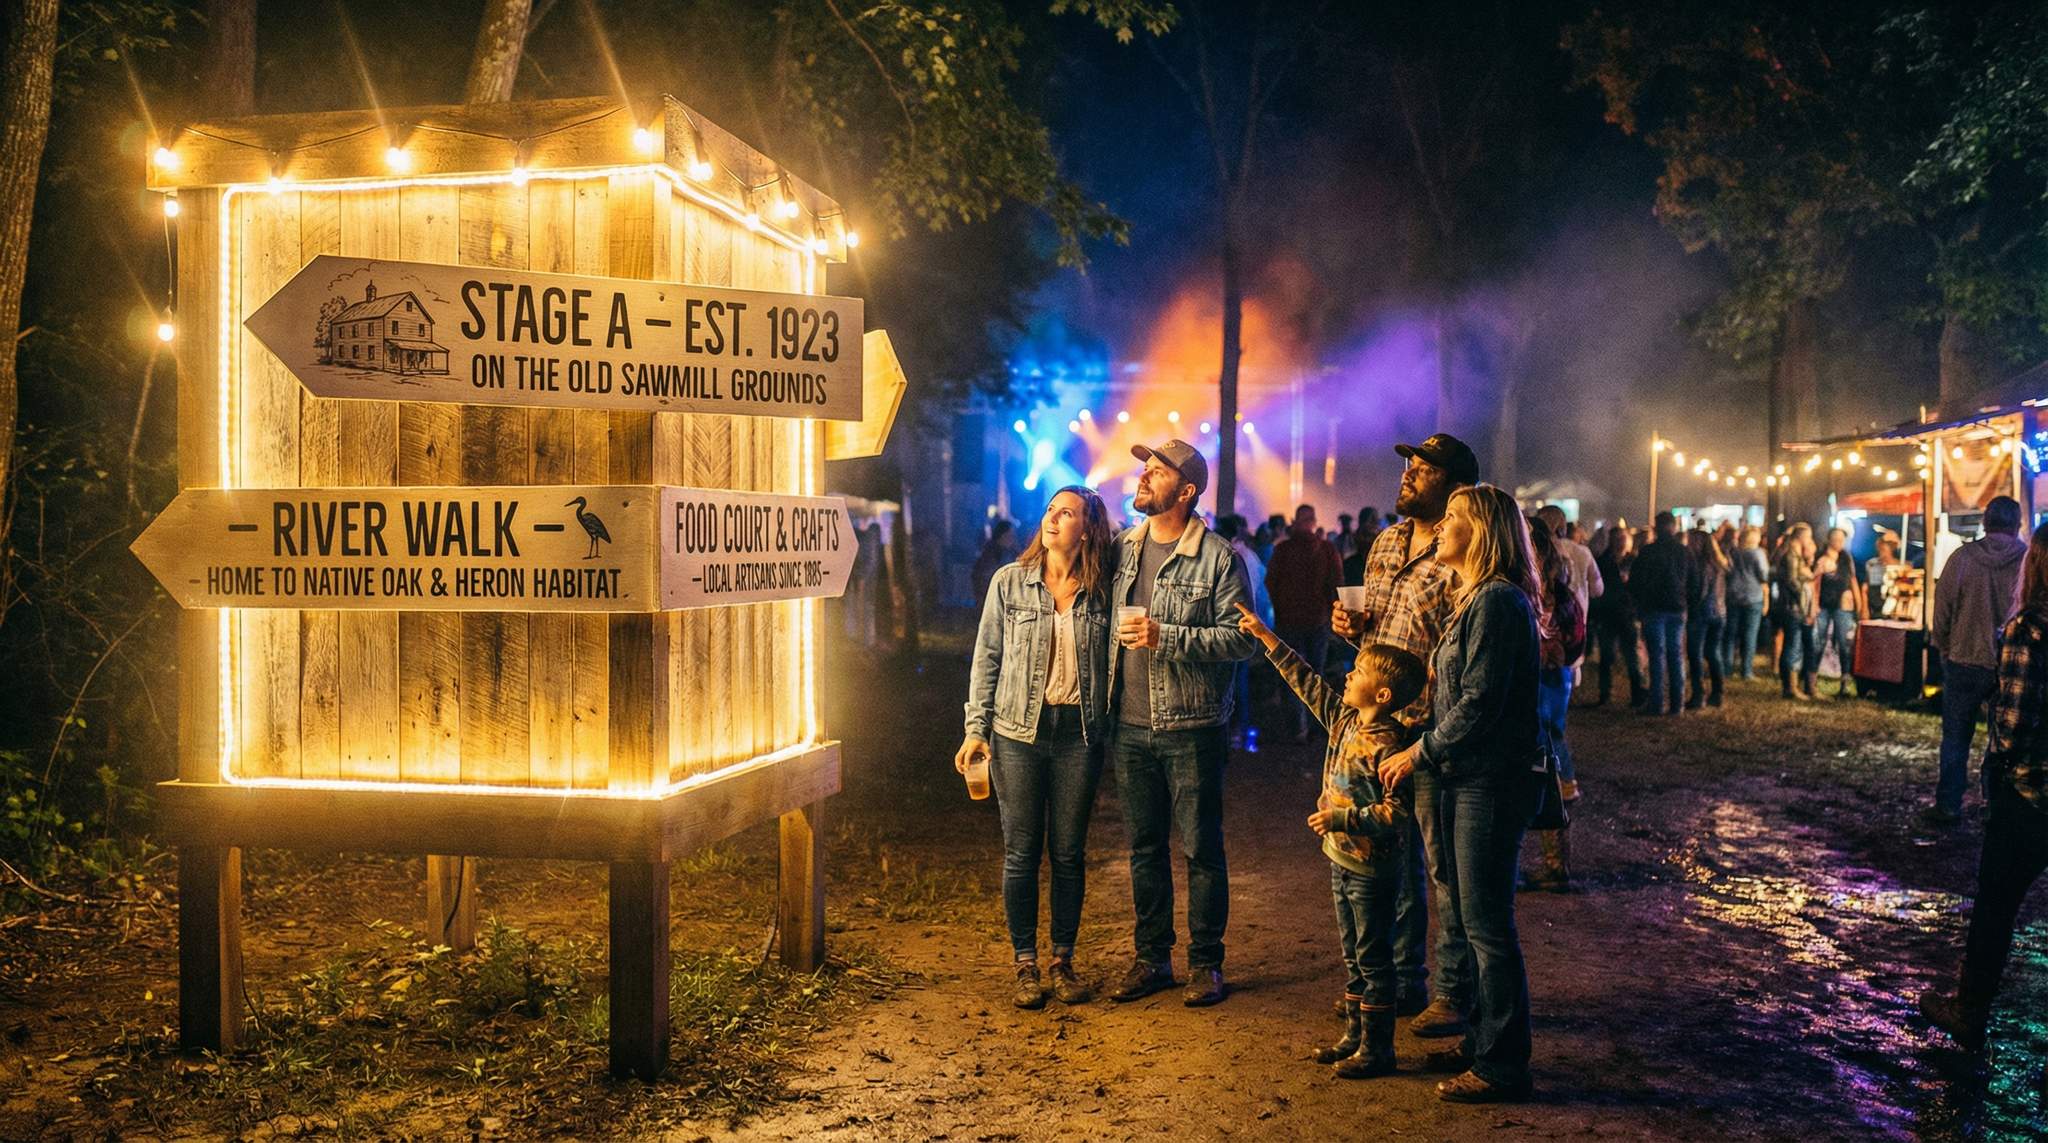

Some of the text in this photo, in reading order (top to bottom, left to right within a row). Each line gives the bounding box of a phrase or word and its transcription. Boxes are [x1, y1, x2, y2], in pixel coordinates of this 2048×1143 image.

[461, 279, 592, 345] STAGE
[606, 292, 632, 349] A
[685, 299, 753, 356] EST.
[767, 306, 839, 362] 1923
[472, 353, 827, 405] ON THE OLD SAWMILL GROUNDS
[273, 501, 388, 556] RIVER
[402, 501, 520, 557] WALK
[676, 501, 840, 554] FOOD COURT & CRAFTS
[207, 566, 265, 595] HOME
[271, 567, 297, 596] TO
[304, 567, 375, 596] NATIVE
[382, 567, 423, 597] OAK
[430, 567, 448, 596] &
[456, 567, 525, 597] HERON
[533, 568, 622, 599] HABITAT
[703, 563, 732, 593] LOCAL
[735, 561, 777, 591] ARTISANS
[779, 561, 802, 587] SINCE
